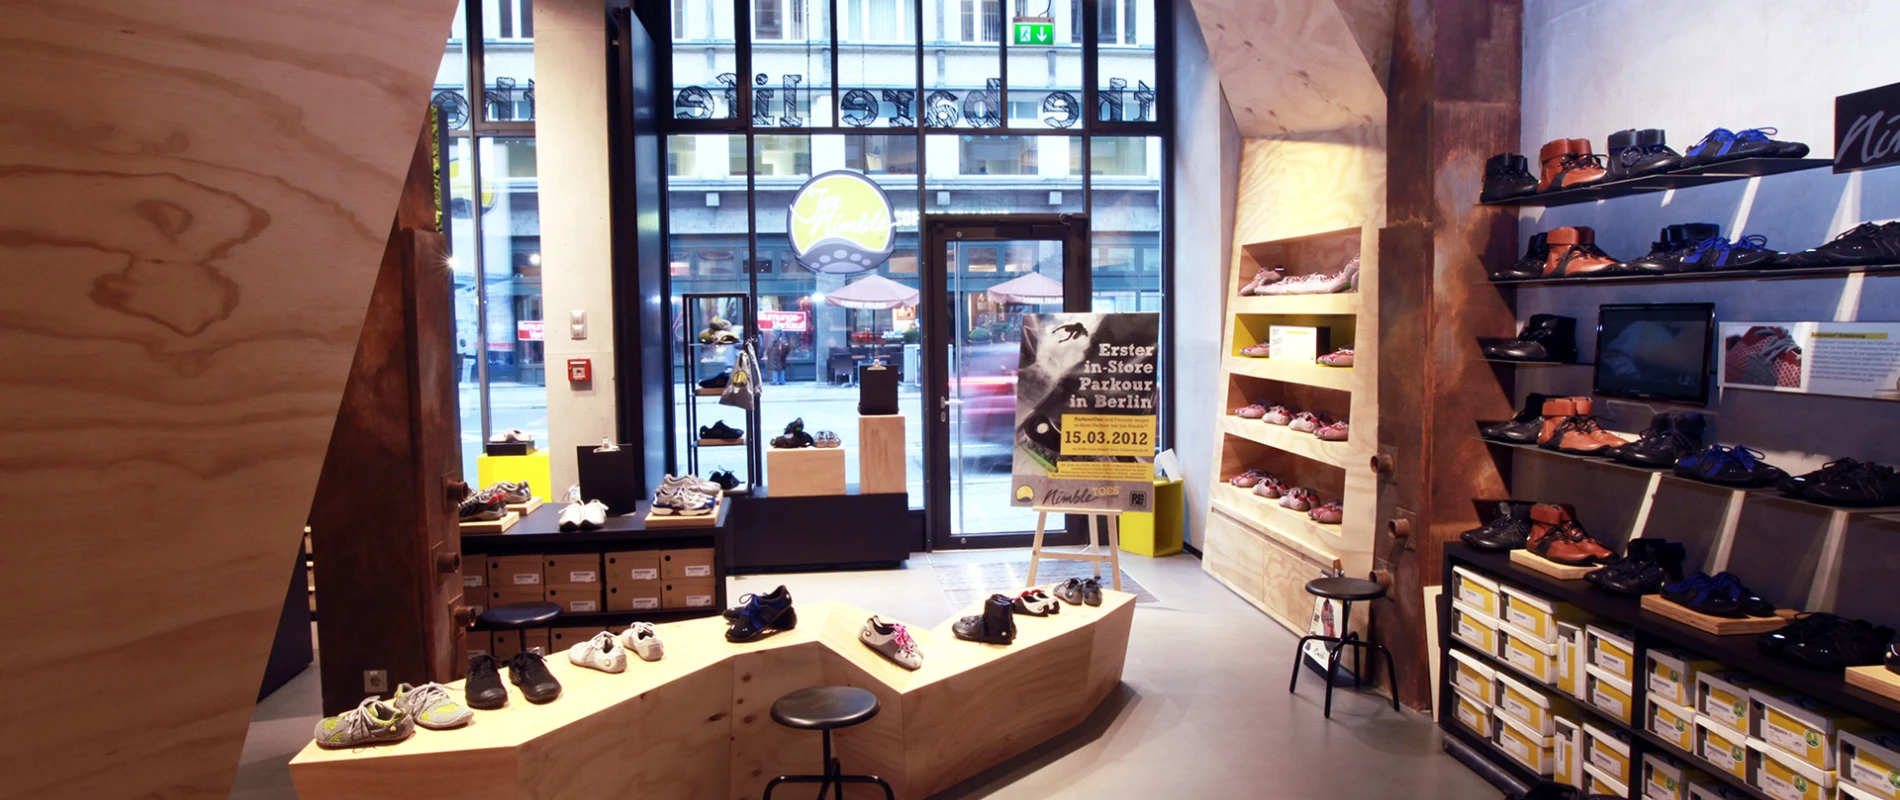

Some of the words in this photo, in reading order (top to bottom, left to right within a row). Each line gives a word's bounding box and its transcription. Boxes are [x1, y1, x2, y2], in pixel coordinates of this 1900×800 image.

[790, 188, 842, 223] Joe
[809, 207, 896, 236] Nimble
[1098, 343, 1155, 357] Erster
[1084, 360, 1154, 374] in-Store
[1079, 377, 1153, 391] Parkour
[1069, 395, 1088, 408] in
[1094, 394, 1153, 409] Berlin
[1065, 431, 1148, 445] 15.03.2012
[1043, 488, 1098, 505] Nimble
[1092, 486, 1120, 497] TOES
